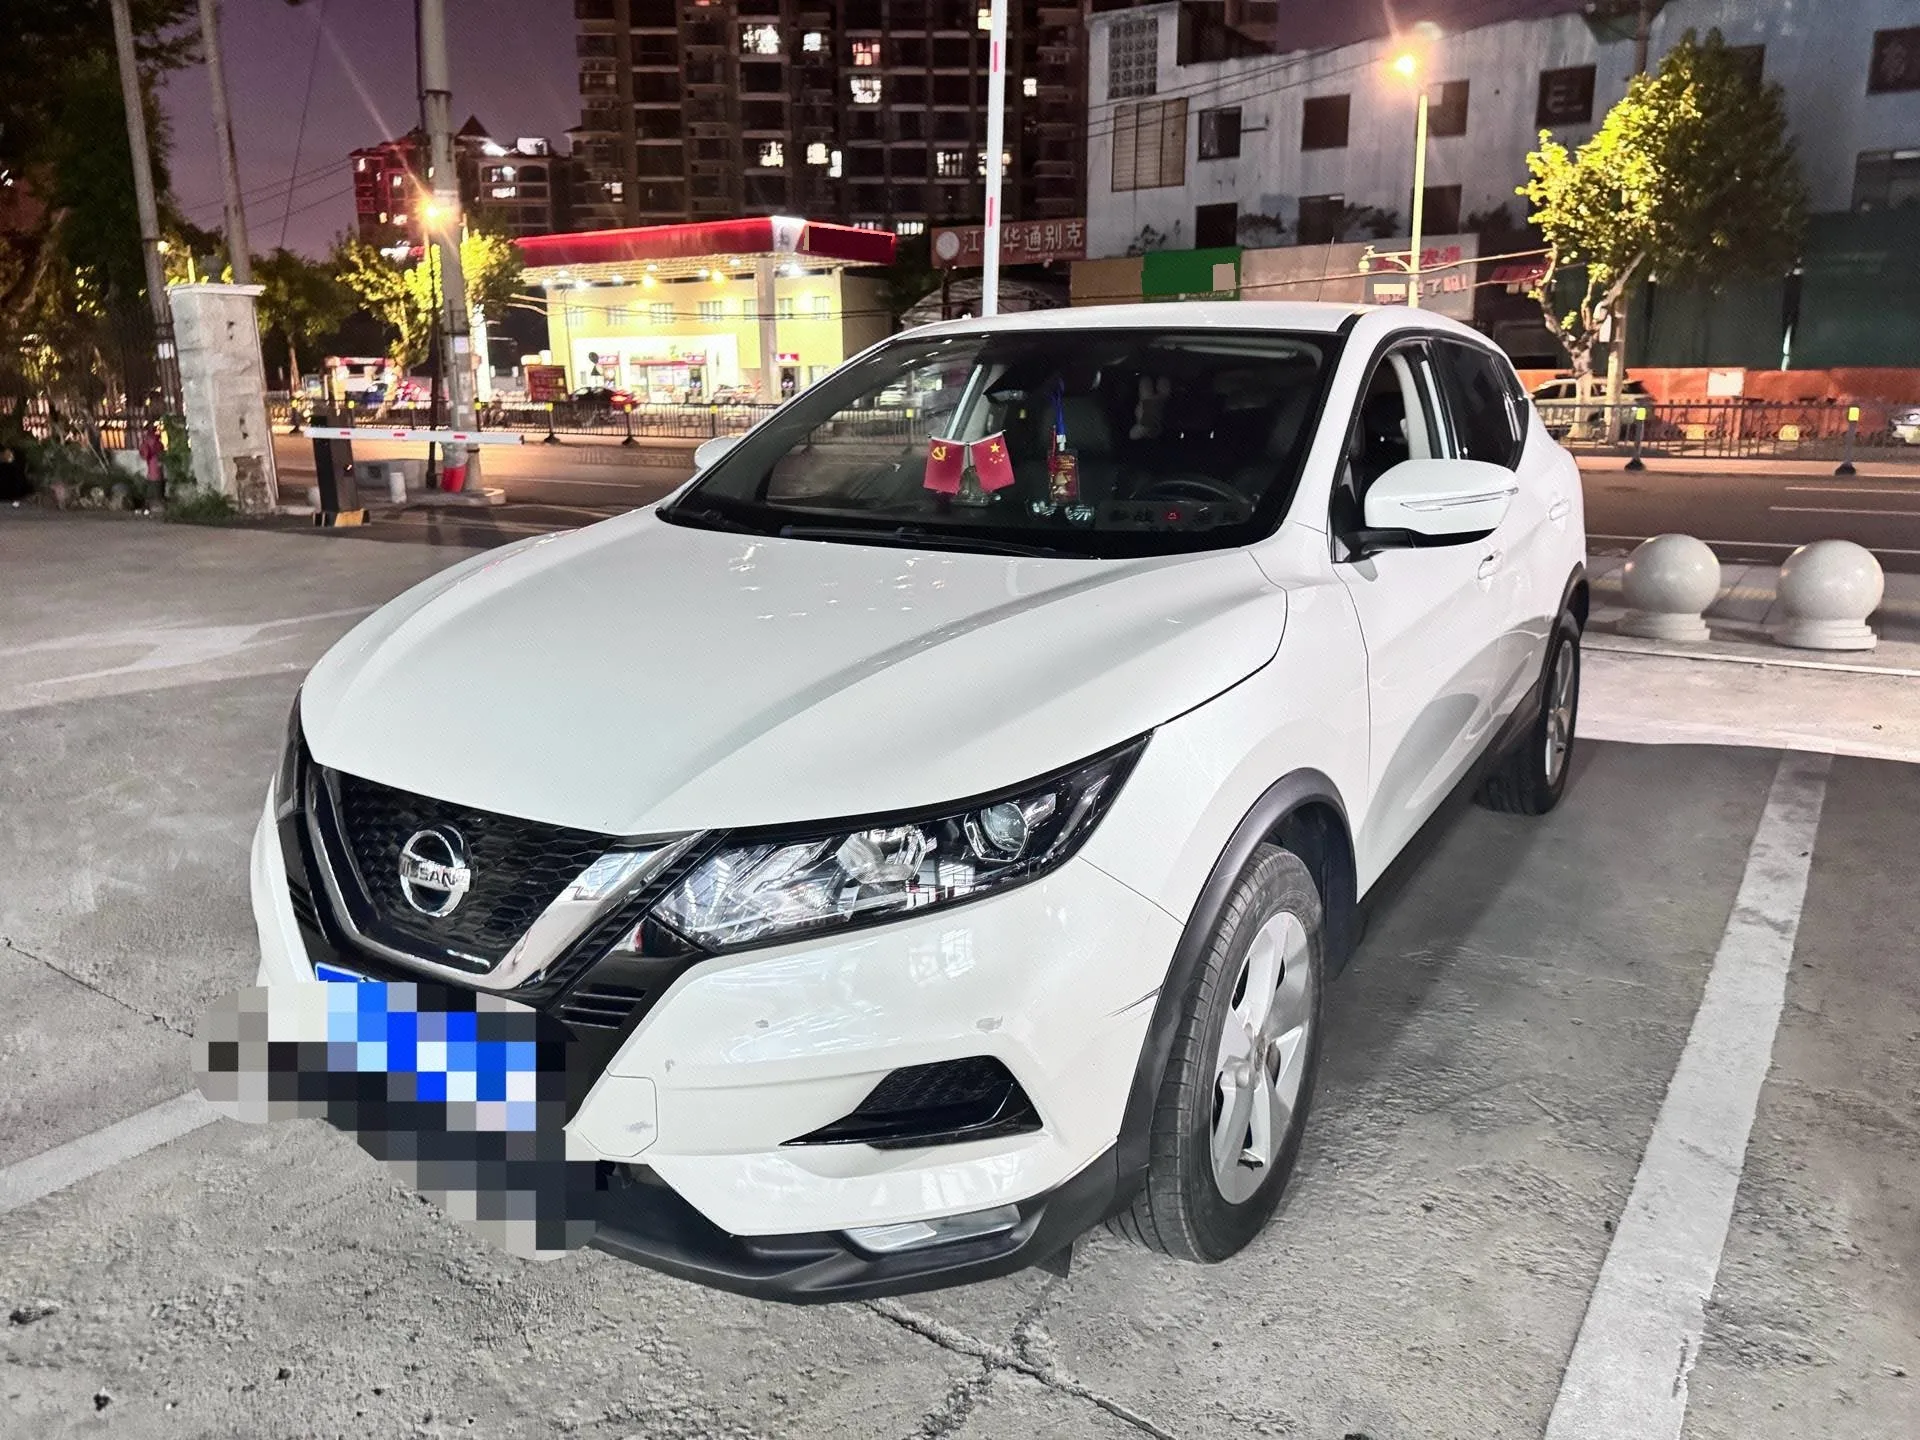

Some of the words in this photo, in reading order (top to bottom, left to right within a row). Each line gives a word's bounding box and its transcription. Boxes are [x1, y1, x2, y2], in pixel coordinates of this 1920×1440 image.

[962, 222, 1083, 254] 江华通别克
